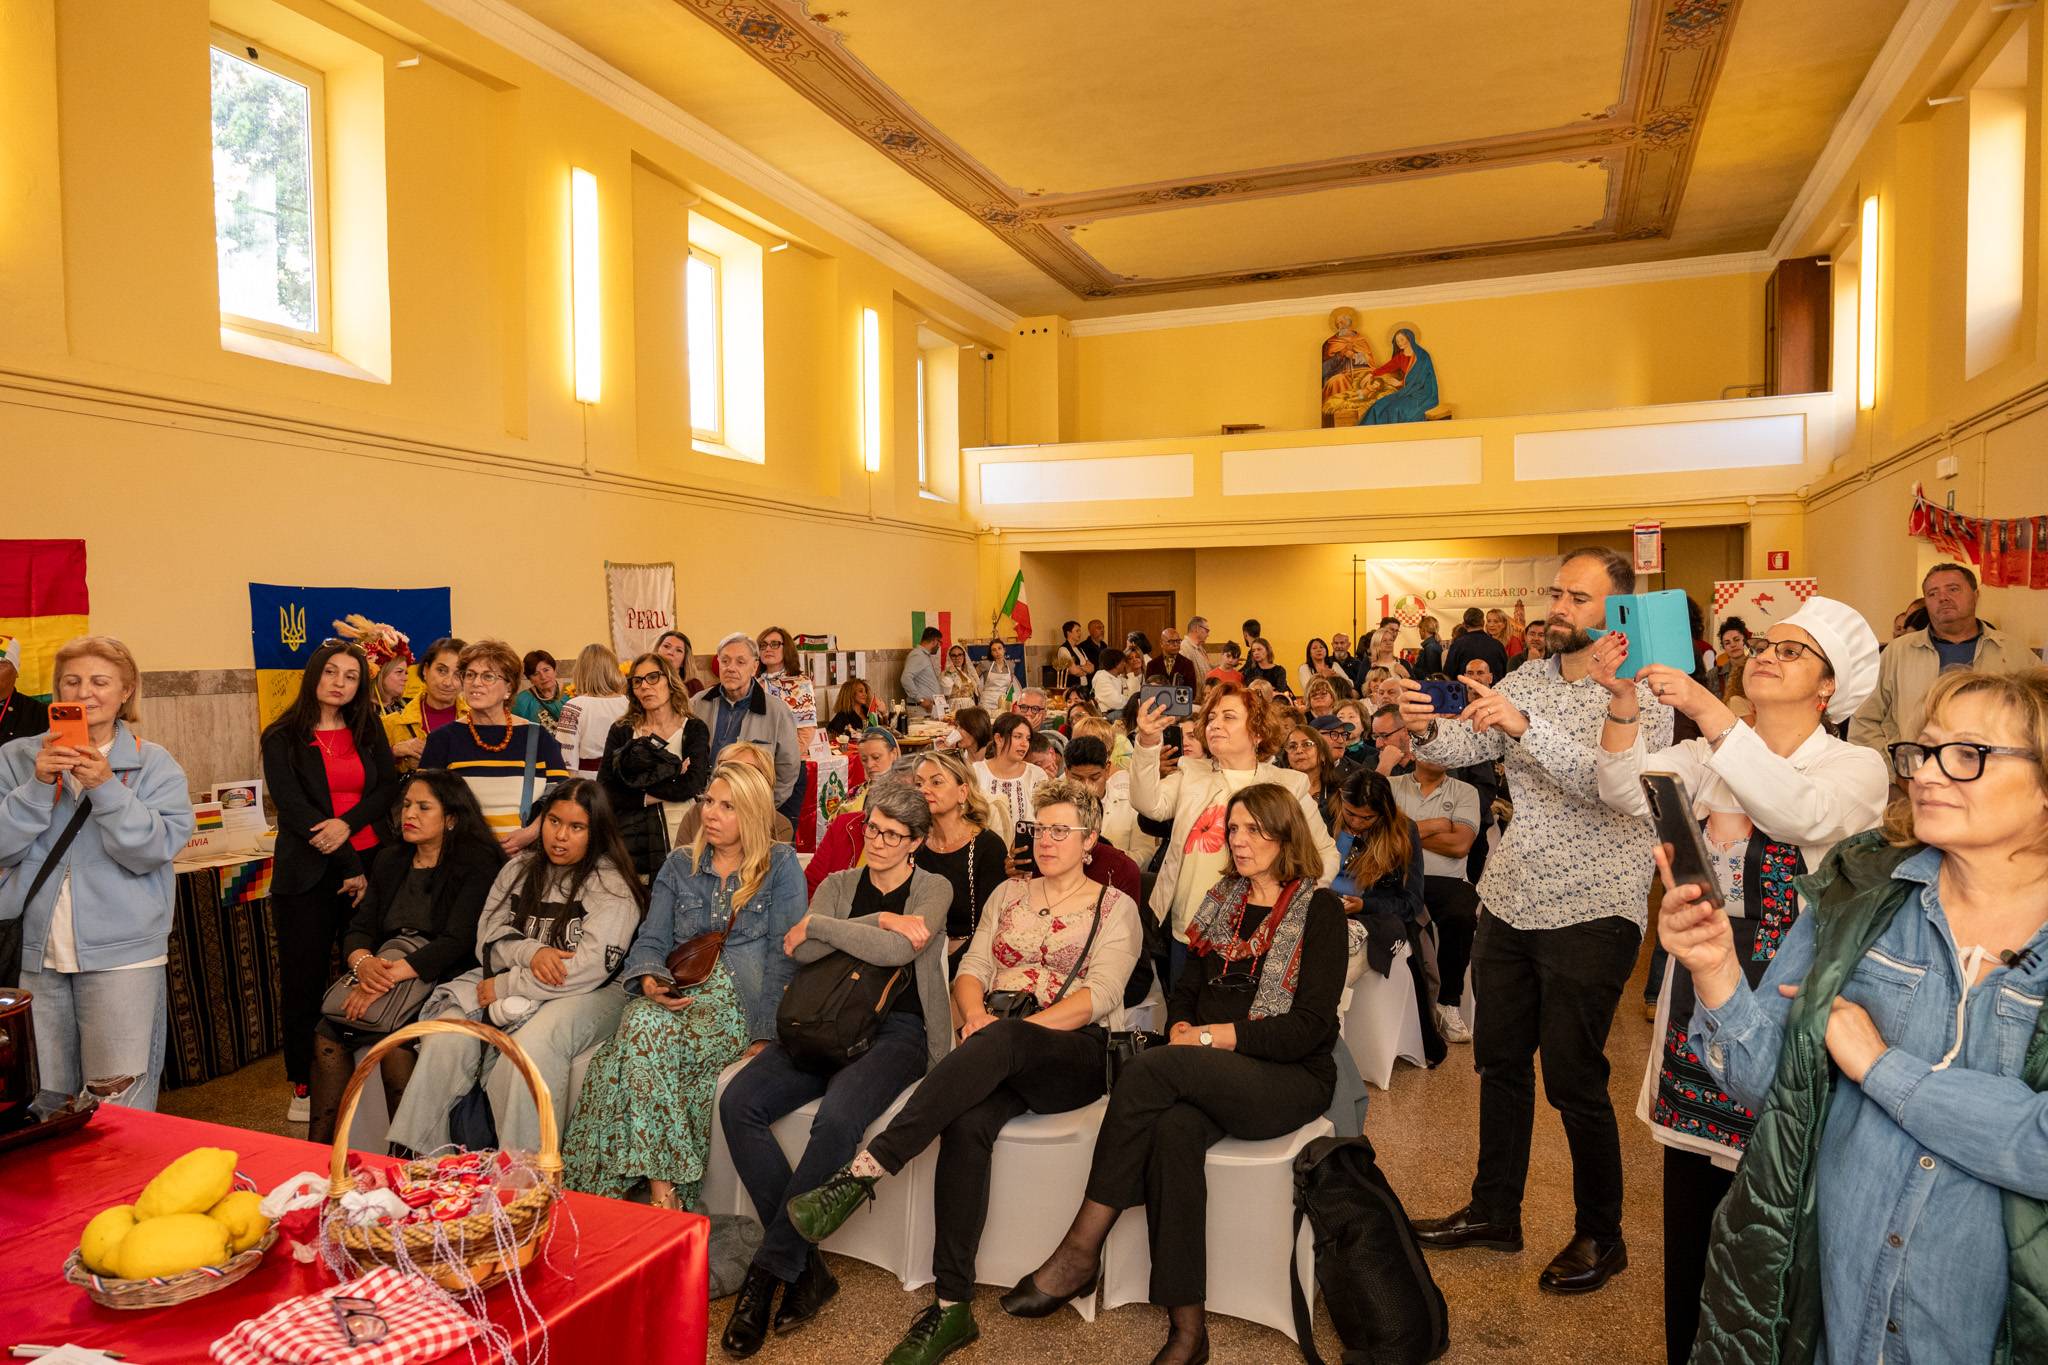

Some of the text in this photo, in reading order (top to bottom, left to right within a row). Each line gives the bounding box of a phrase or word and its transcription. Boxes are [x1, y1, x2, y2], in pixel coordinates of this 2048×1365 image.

[1444, 587, 1528, 598] ANNIVERSARIO
[627, 607, 669, 630] PERU
[186, 838, 209, 848] LIVIA
